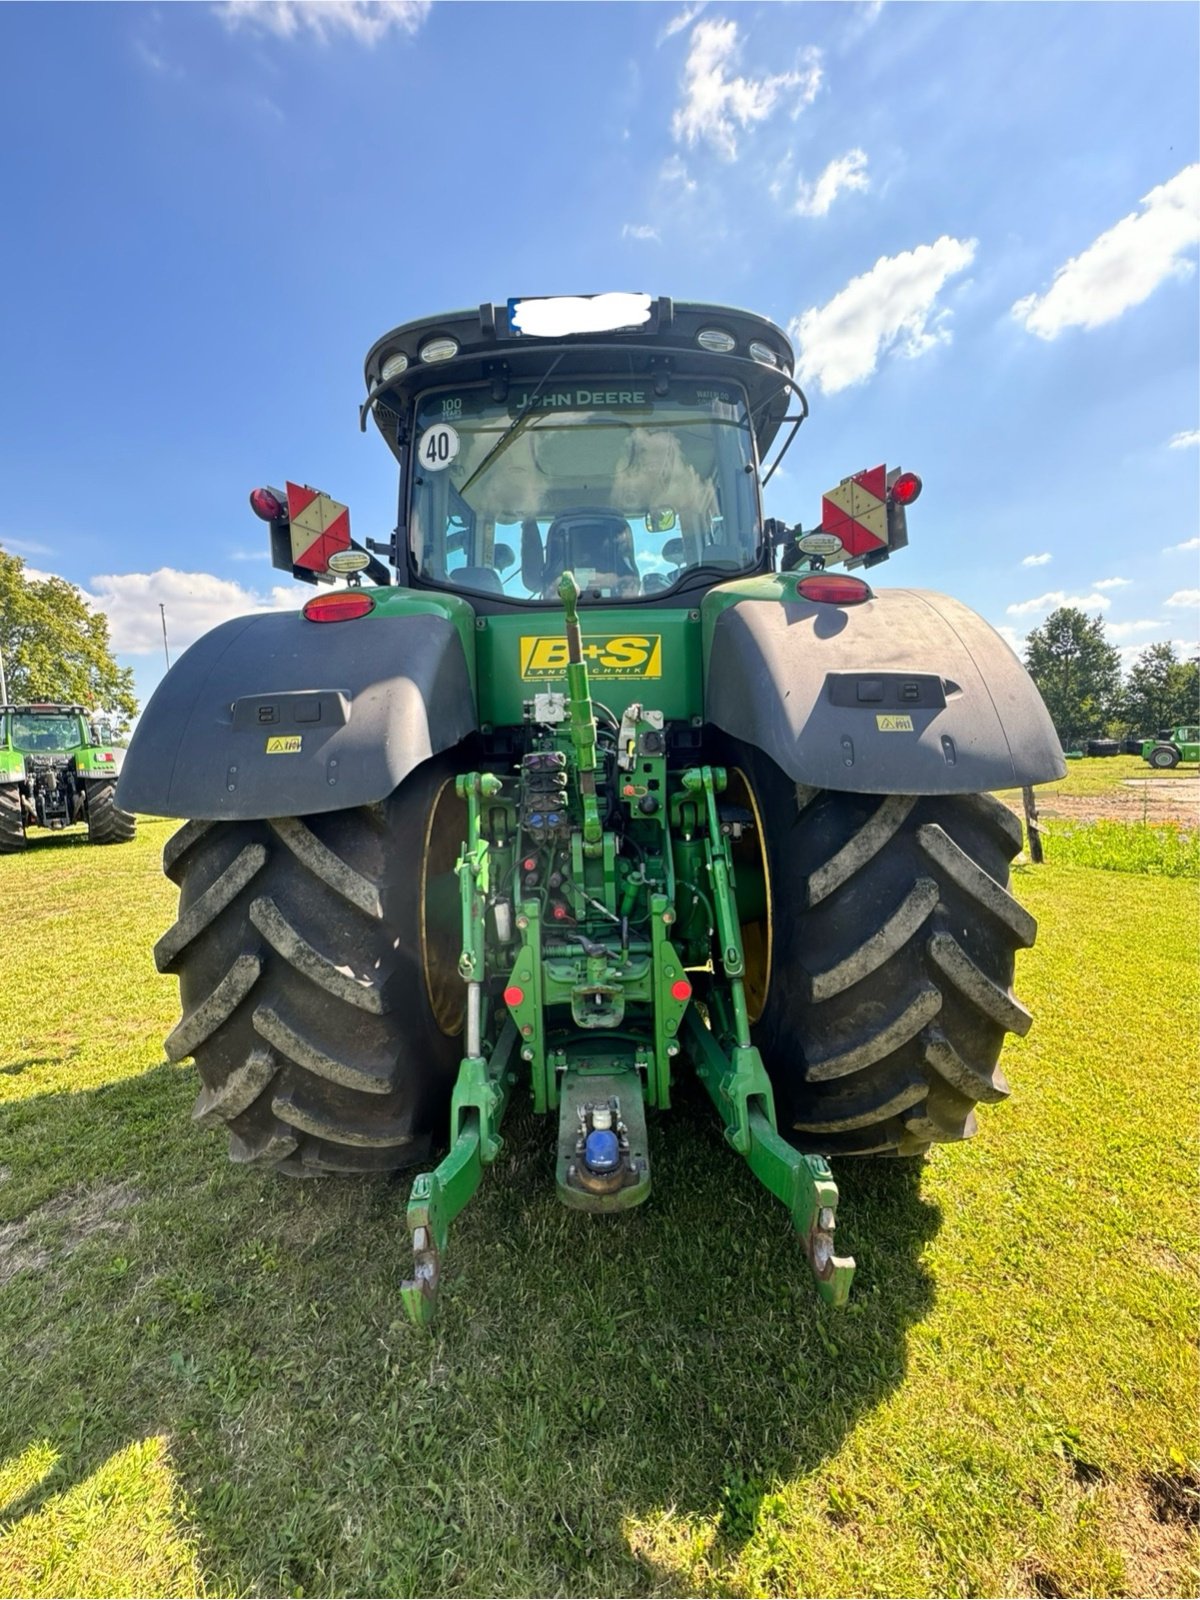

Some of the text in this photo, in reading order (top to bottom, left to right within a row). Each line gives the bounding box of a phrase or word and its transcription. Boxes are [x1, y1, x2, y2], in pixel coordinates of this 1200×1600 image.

[441, 398, 462, 411] 100
[516, 390, 646, 408] JOHN DEERE
[426, 431, 449, 462] 40
[526, 668, 641, 676] LANDCHNIK
